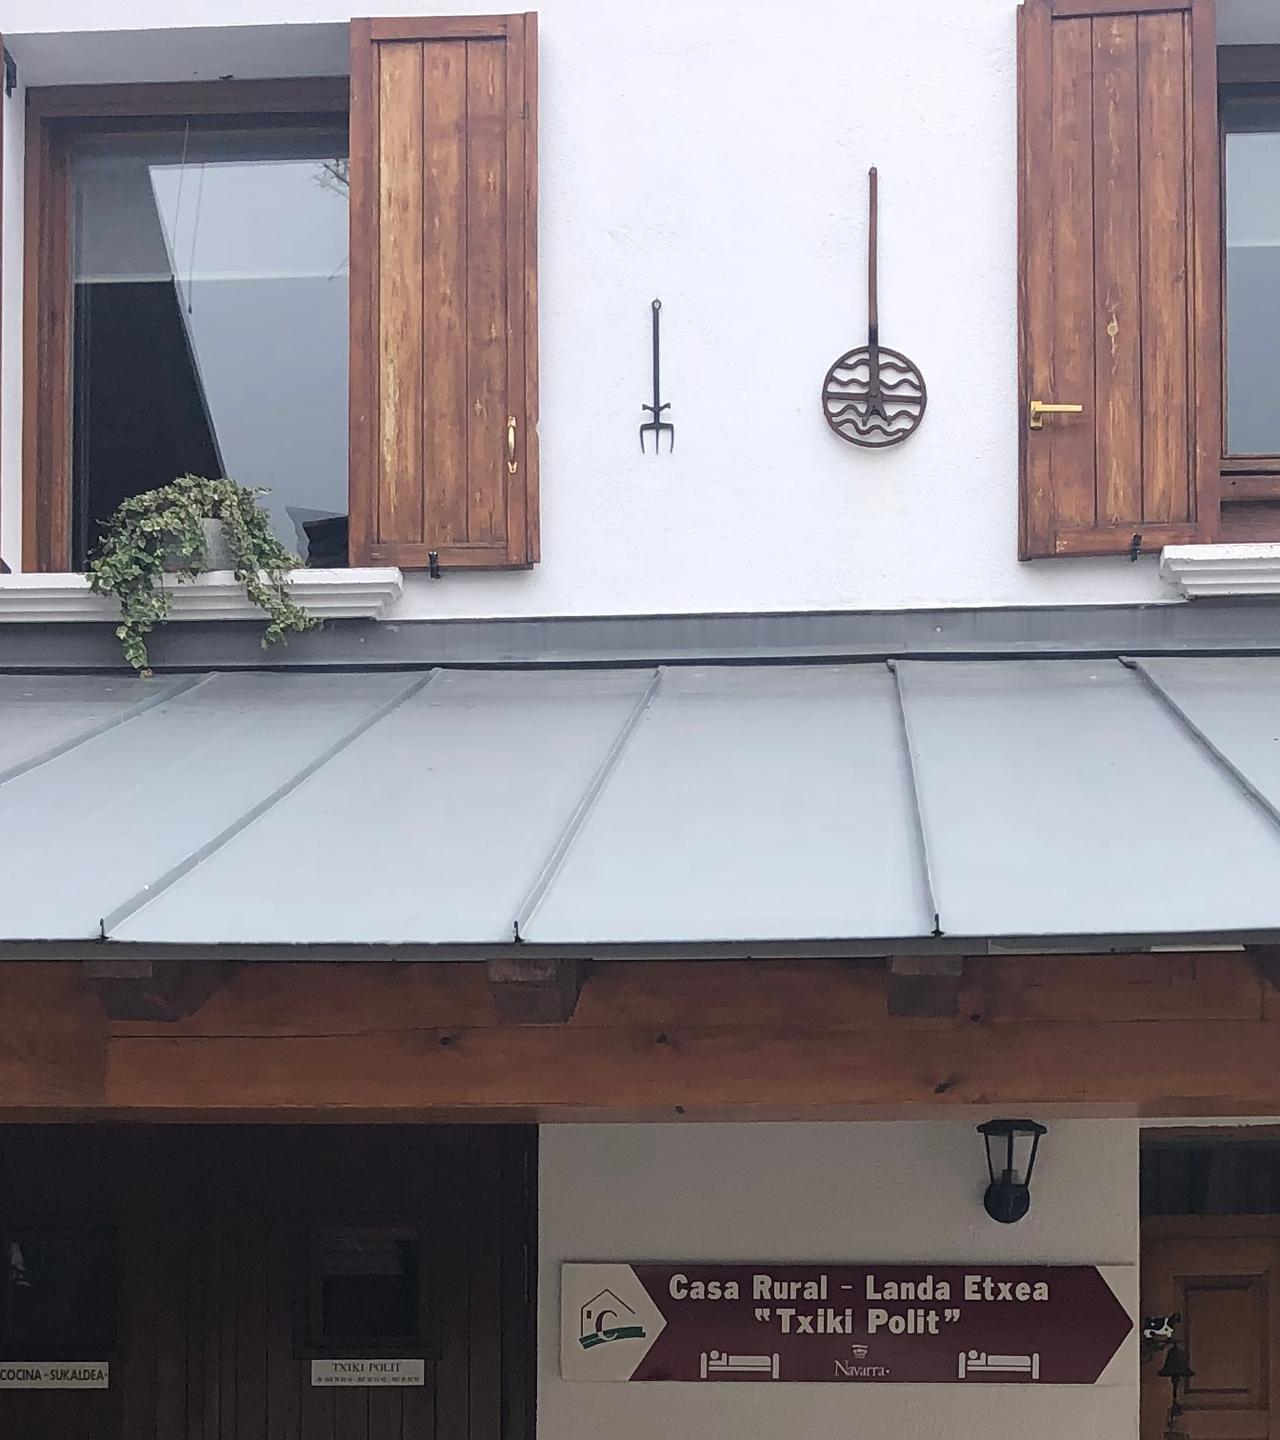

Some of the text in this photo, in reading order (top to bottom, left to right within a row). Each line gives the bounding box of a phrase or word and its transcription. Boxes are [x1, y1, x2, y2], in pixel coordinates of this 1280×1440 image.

[668, 1273, 740, 1301] Casa
[752, 1273, 829, 1301] Rural
[865, 1273, 951, 1301] Landa
[964, 1274, 1050, 1302] Etxea
[331, 1362, 401, 1373] TXIKI POLIT
